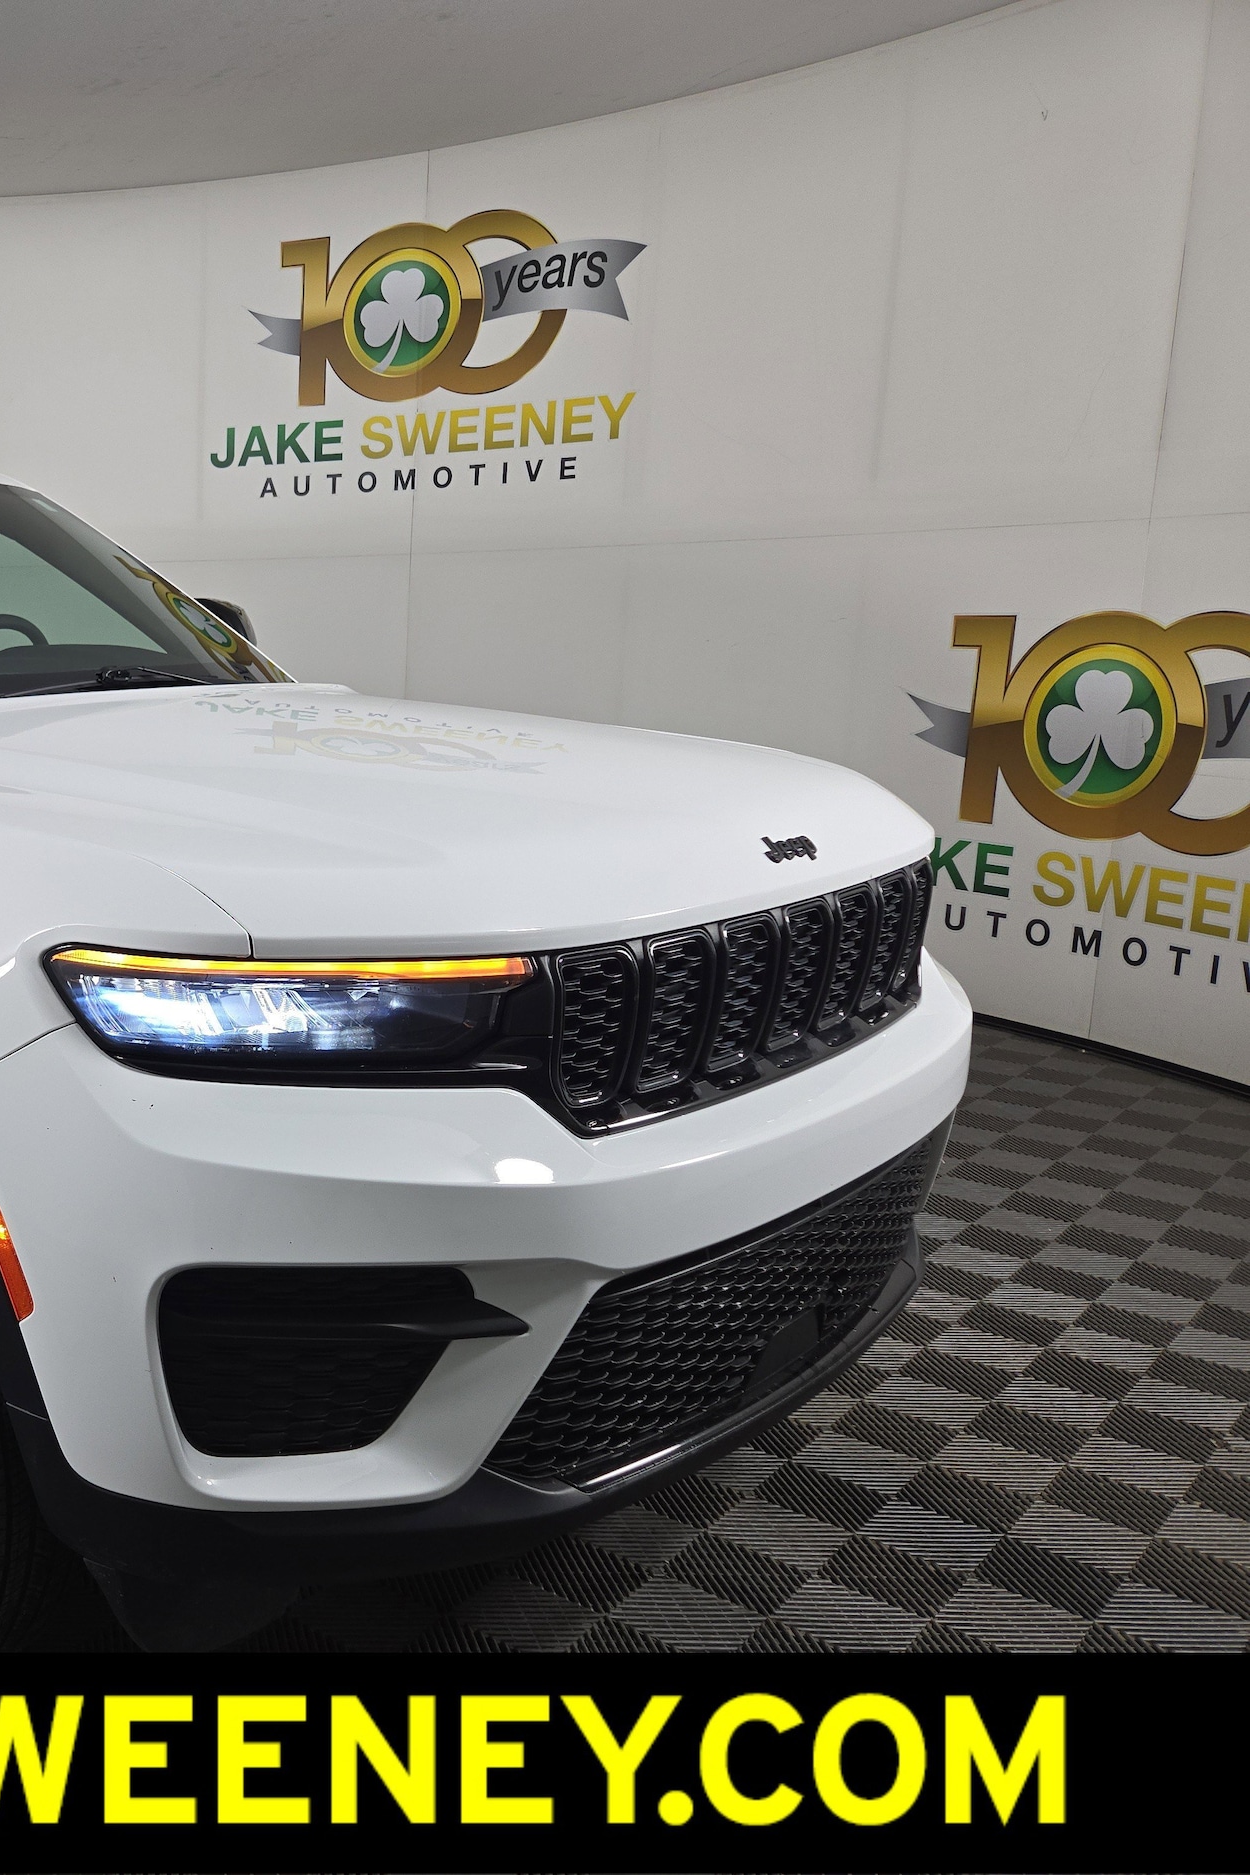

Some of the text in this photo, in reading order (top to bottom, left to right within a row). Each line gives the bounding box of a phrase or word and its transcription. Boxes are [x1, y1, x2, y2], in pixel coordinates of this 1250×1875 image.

[281, 209, 609, 407] 100 years
[210, 392, 636, 469] JAKE SWEENEY
[259, 457, 578, 499] AUTOMOTIVE
[761, 835, 817, 863] Jeep
[930, 837, 1250, 943] KE SWEE
[944, 903, 1250, 994] UTOMOTI
